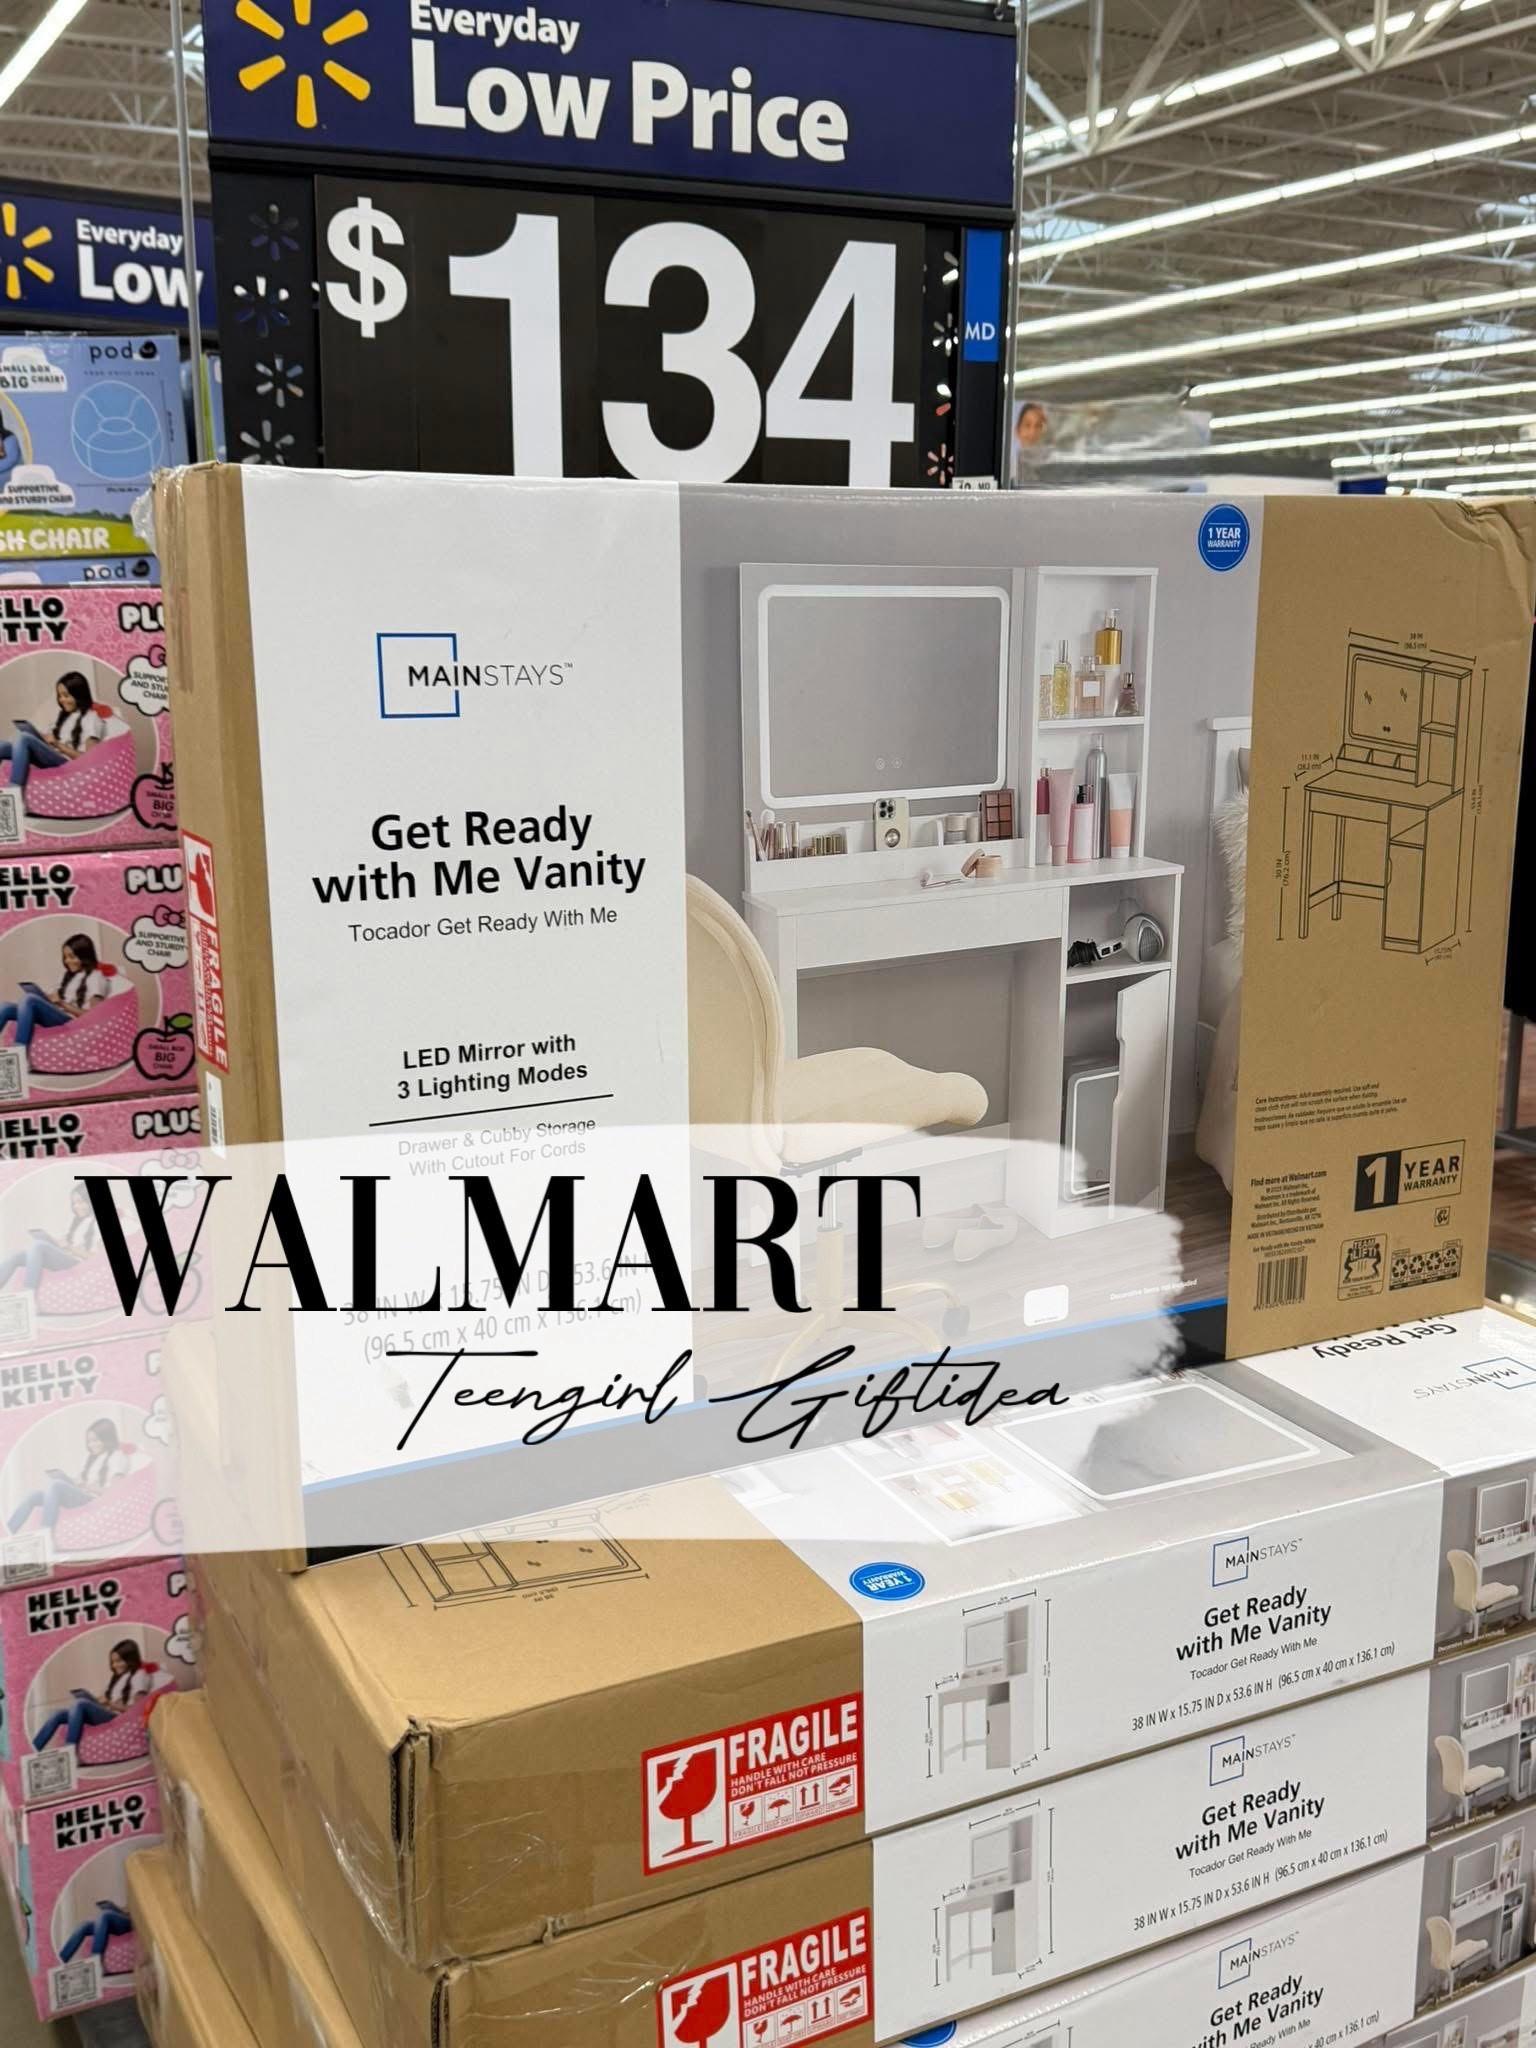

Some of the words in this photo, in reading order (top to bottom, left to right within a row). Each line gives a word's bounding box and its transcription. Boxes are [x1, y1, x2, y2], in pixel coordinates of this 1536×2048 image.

[411, 0, 580, 54] Everyday
[411, 38, 611, 140] Low
[632, 60, 848, 163] Price
[76, 219, 183, 254] Everyday
[78, 244, 203, 309] Low
[965, 322, 996, 341] MD
[89, 341, 133, 364] pod
[29, 527, 110, 551] CHAIR
[1207, 539, 1241, 548] WARRANTY
[1208, 527, 1213, 539] 1
[1216, 527, 1241, 539] YEAR
[83, 561, 126, 580] pod
[0, 597, 64, 618] LLO
[371, 813, 450, 851] Get
[465, 804, 592, 851] Ready
[312, 861, 417, 904] with
[434, 860, 500, 897] Me
[514, 850, 646, 894] Vanity
[348, 920, 431, 942] Tocador
[437, 917, 472, 936] Get
[478, 912, 539, 934] Ready
[544, 908, 585, 929] With
[590, 906, 618, 924] Me
[207, 928, 228, 1068] FRAGILE
[155, 1052, 176, 1063] BIG
[403, 1046, 451, 1070] LED
[458, 1041, 526, 1065] Mirror
[531, 1034, 576, 1055] with
[397, 1080, 411, 1099] 3
[418, 1069, 511, 1099] Lighting
[517, 1061, 588, 1085] Modes
[0, 1112, 80, 1138] ELLO
[398, 1135, 458, 1156] Drawer
[463, 1132, 475, 1147] &
[480, 1127, 532, 1146] Cubby
[536, 1119, 596, 1139] Storage
[409, 1159, 446, 1177] With
[451, 1151, 505, 1171] Cutout
[510, 1147, 536, 1163] For
[540, 1140, 586, 1159] Cords
[1364, 1156, 1388, 1204] 1
[1404, 1155, 1460, 1180] YEAR
[1403, 1173, 1458, 1192] WARRANTY
[364, 1330, 415, 1365] (965
[422, 1329, 450, 1350] cm
[457, 1326, 468, 1345] x
[473, 1315, 498, 1340] 40
[504, 1312, 531, 1336] cm
[1312, 1333, 1406, 1359] Ready
[1402, 1323, 1458, 1342] Get
[1, 1355, 95, 1387] HELLO
[2, 1375, 98, 1408] KITTY
[28, 1580, 118, 1612] HELLO
[866, 1576, 905, 1592] YEAR
[29, 1598, 122, 1632] KITTY
[1204, 1602, 1240, 1628] Get
[1247, 1585, 1307, 1617] Ready
[1176, 1632, 1223, 1661] with
[1230, 1623, 1261, 1648] Me
[1268, 1605, 1332, 1635] Vanity
[1190, 1662, 1228, 1681] Tocador
[1230, 1657, 1248, 1669] Get
[1249, 1649, 1279, 1664] Ready
[1280, 1642, 1302, 1656] With
[1303, 1637, 1318, 1649] Me
[1131, 1717, 1144, 1731] 38
[1145, 1713, 1157, 1727] IN
[1158, 1710, 1168, 1724] W
[1169, 1710, 1176, 1720] x
[1178, 1699, 1203, 1719] 15.75
[1204, 1695, 1215, 1711] IN
[1216, 1692, 1224, 1706] D
[1225, 1693, 1232, 1704] x
[1233, 1684, 1253, 1702] 53.6
[1254, 1680, 1265, 1695] IN
[1265, 1678, 1273, 1691] H
[1278, 1669, 1300, 1690] (96.5
[1301, 1667, 1314, 1681] cm
[1315, 1666, 1321, 1677] x
[1322, 1660, 1334, 1674] 40
[1335, 1656, 1348, 1671] cm
[1349, 1656, 1355, 1667] x
[1356, 1647, 1378, 1664] 136.1
[1381, 1641, 1395, 1658] cm)
[729, 1701, 858, 1775] FRAGILE
[731, 1769, 773, 1788] HANDLE
[774, 1762, 800, 1776] WITH
[801, 1752, 826, 1767] CARE
[731, 1782, 764, 1798] DON'T
[764, 1775, 787, 1789] FALL
[789, 1768, 809, 1782] NOT
[811, 1752, 858, 1774] PRESSURE
[56, 1795, 143, 1829] HELLO
[1202, 1801, 1237, 1826] Get
[1242, 1780, 1301, 1814] Ready
[57, 1812, 146, 1849] KITTY
[1175, 1831, 1221, 1860] with
[1227, 1819, 1258, 1843] Me
[1263, 1797, 1325, 1830] Vanity
[1188, 1859, 1226, 1879] Tocador
[1228, 1853, 1245, 1865] Get
[1246, 1843, 1275, 1859] Ready
[1276, 1835, 1296, 1849] With
[1298, 1829, 1312, 1840] Me
[741, 1915, 867, 1997] FRAGILE
[1210, 2000, 1242, 2027] Get
[1247, 1974, 1303, 2011] Ready
[1233, 2016, 1262, 2040] Me
[1267, 1987, 1324, 2023] Vanity
